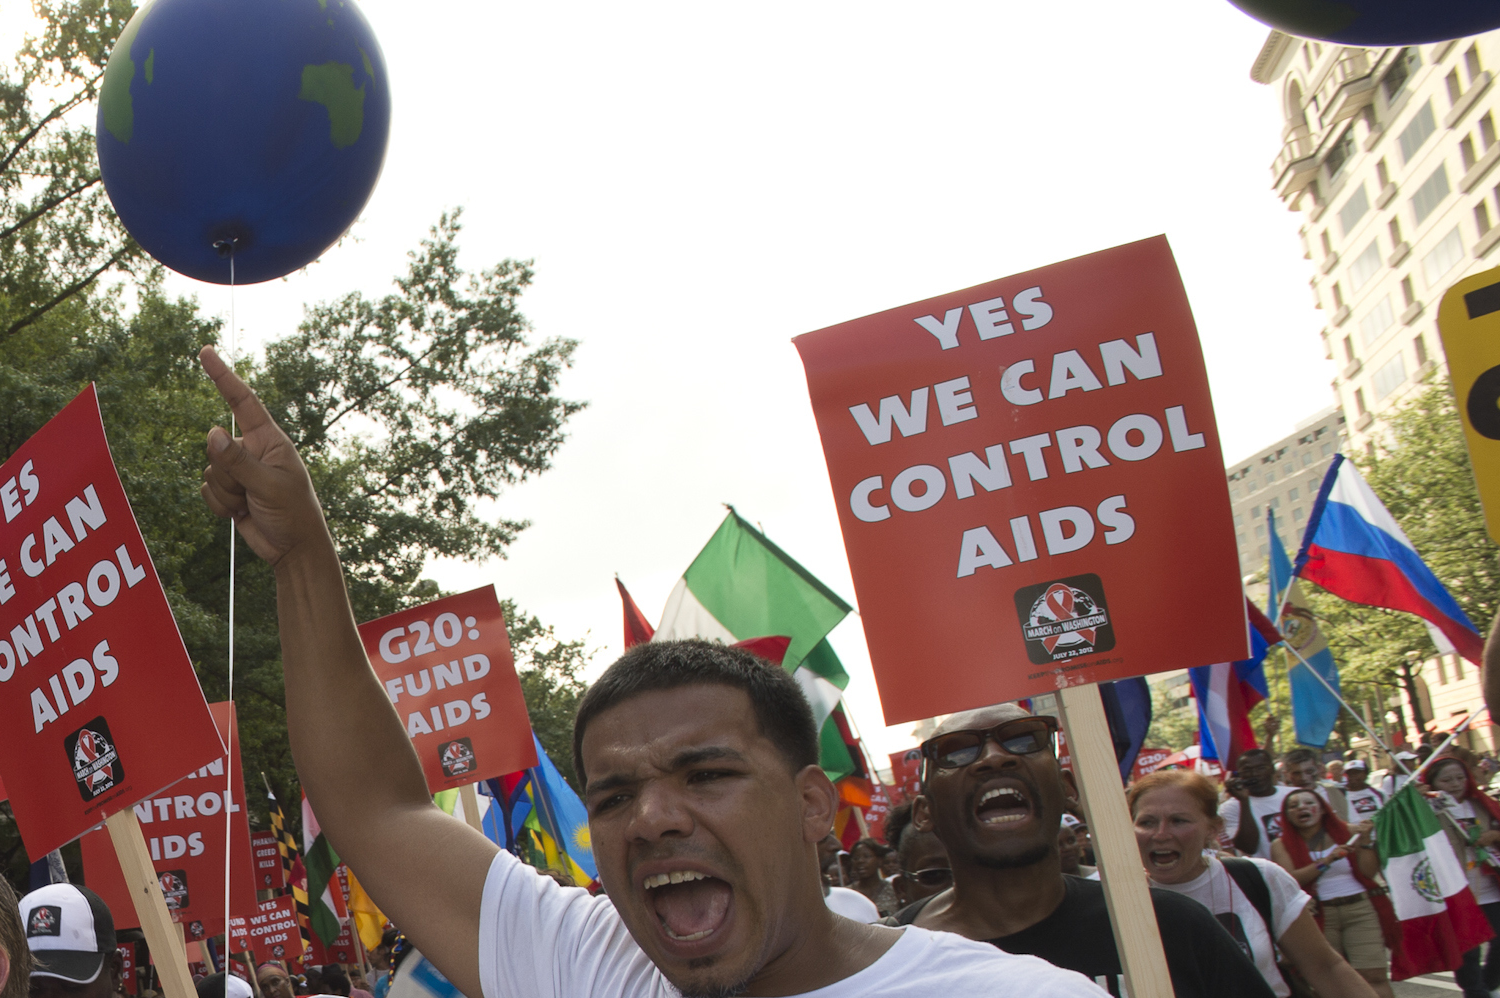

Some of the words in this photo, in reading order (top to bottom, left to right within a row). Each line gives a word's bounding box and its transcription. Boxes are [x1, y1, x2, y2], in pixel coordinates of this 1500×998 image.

[913, 285, 1055, 352] YES
[848, 375, 980, 447] WE
[1000, 331, 1164, 407] CAN
[849, 404, 1207, 524] CONTROL
[20, 483, 108, 578] CAN
[956, 494, 1137, 579] AIDS
[379, 612, 480, 664] G20:
[1027, 625, 1053, 638] MARCH
[1053, 625, 1062, 633] on
[1061, 614, 1106, 632] WASHINGTON
[1053, 651, 1068, 660] JULY
[28, 638, 120, 734] AIDS
[385, 653, 491, 705] FUND
[407, 692, 492, 739] AIDS
[133, 790, 240, 824] NTROL
[150, 832, 205, 861] IDS
[256, 848, 277, 857] GREED
[259, 859, 275, 869] KILLS
[250, 914, 268, 926] WE
[269, 909, 291, 922] CAN
[259, 901, 277, 912] YES
[231, 927, 248, 938] AIDS
[250, 919, 297, 937] CONTROL
[264, 933, 288, 946] AIDS
